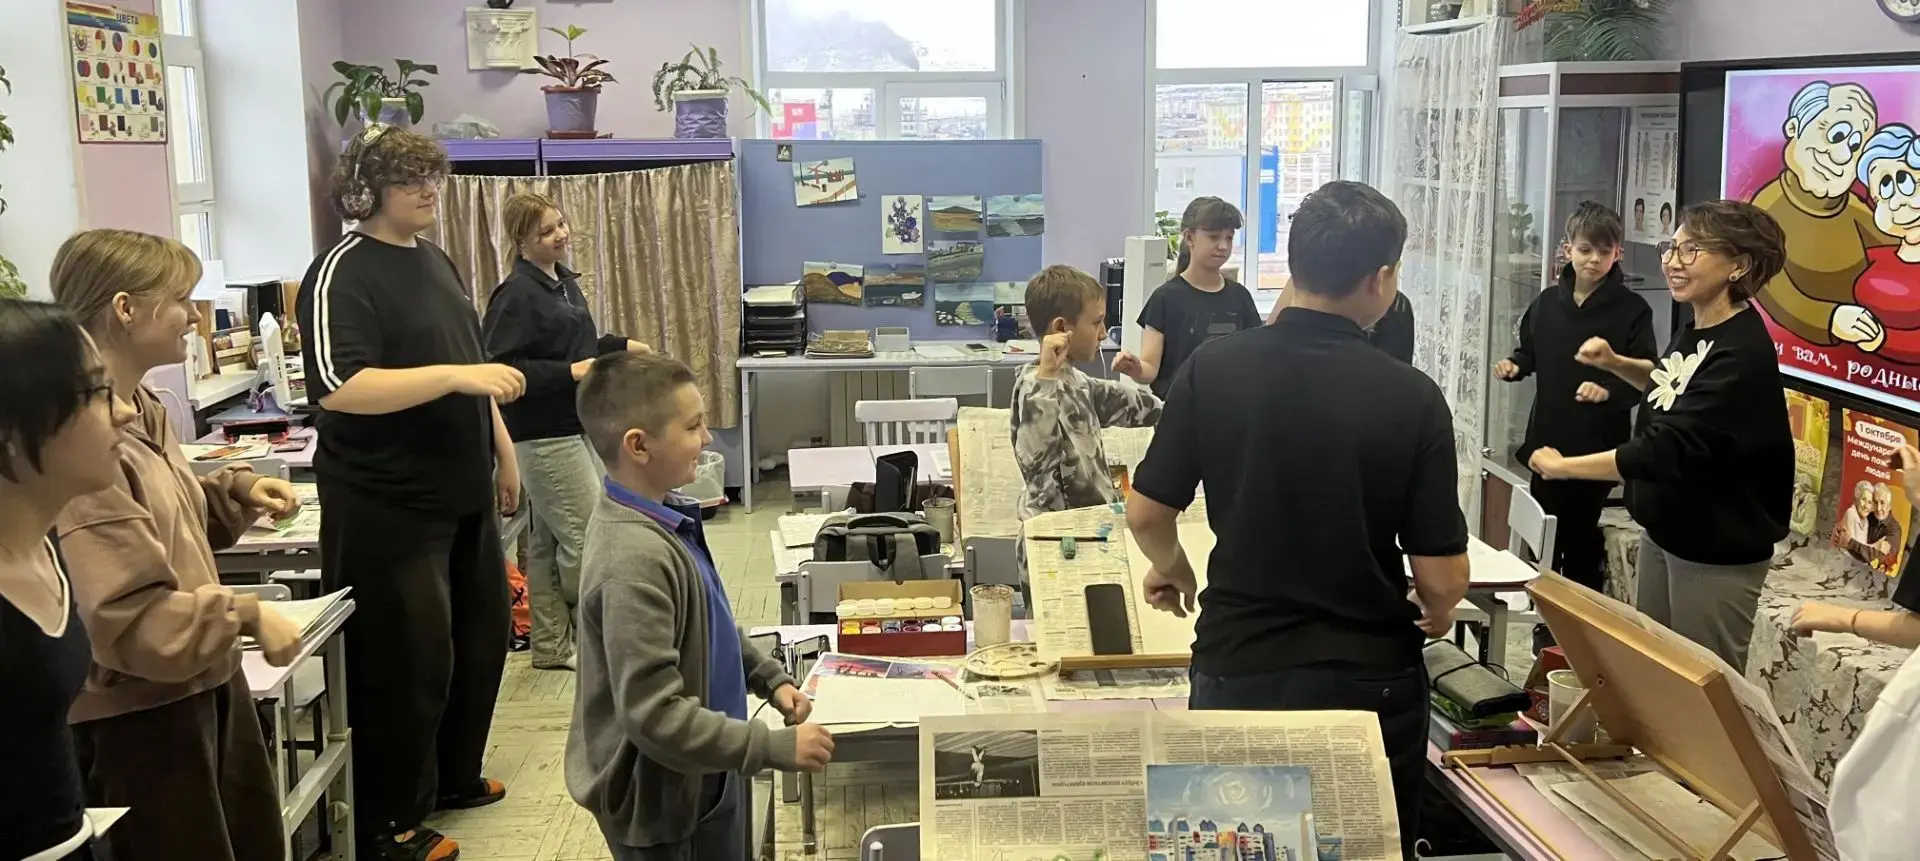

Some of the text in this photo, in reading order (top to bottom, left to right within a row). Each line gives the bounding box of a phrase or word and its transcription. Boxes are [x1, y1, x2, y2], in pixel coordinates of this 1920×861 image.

[1792, 345, 1838, 372] вам,
[1865, 427, 1901, 444] октября
[1851, 449, 1870, 461] день
[1865, 466, 1891, 480] людей
